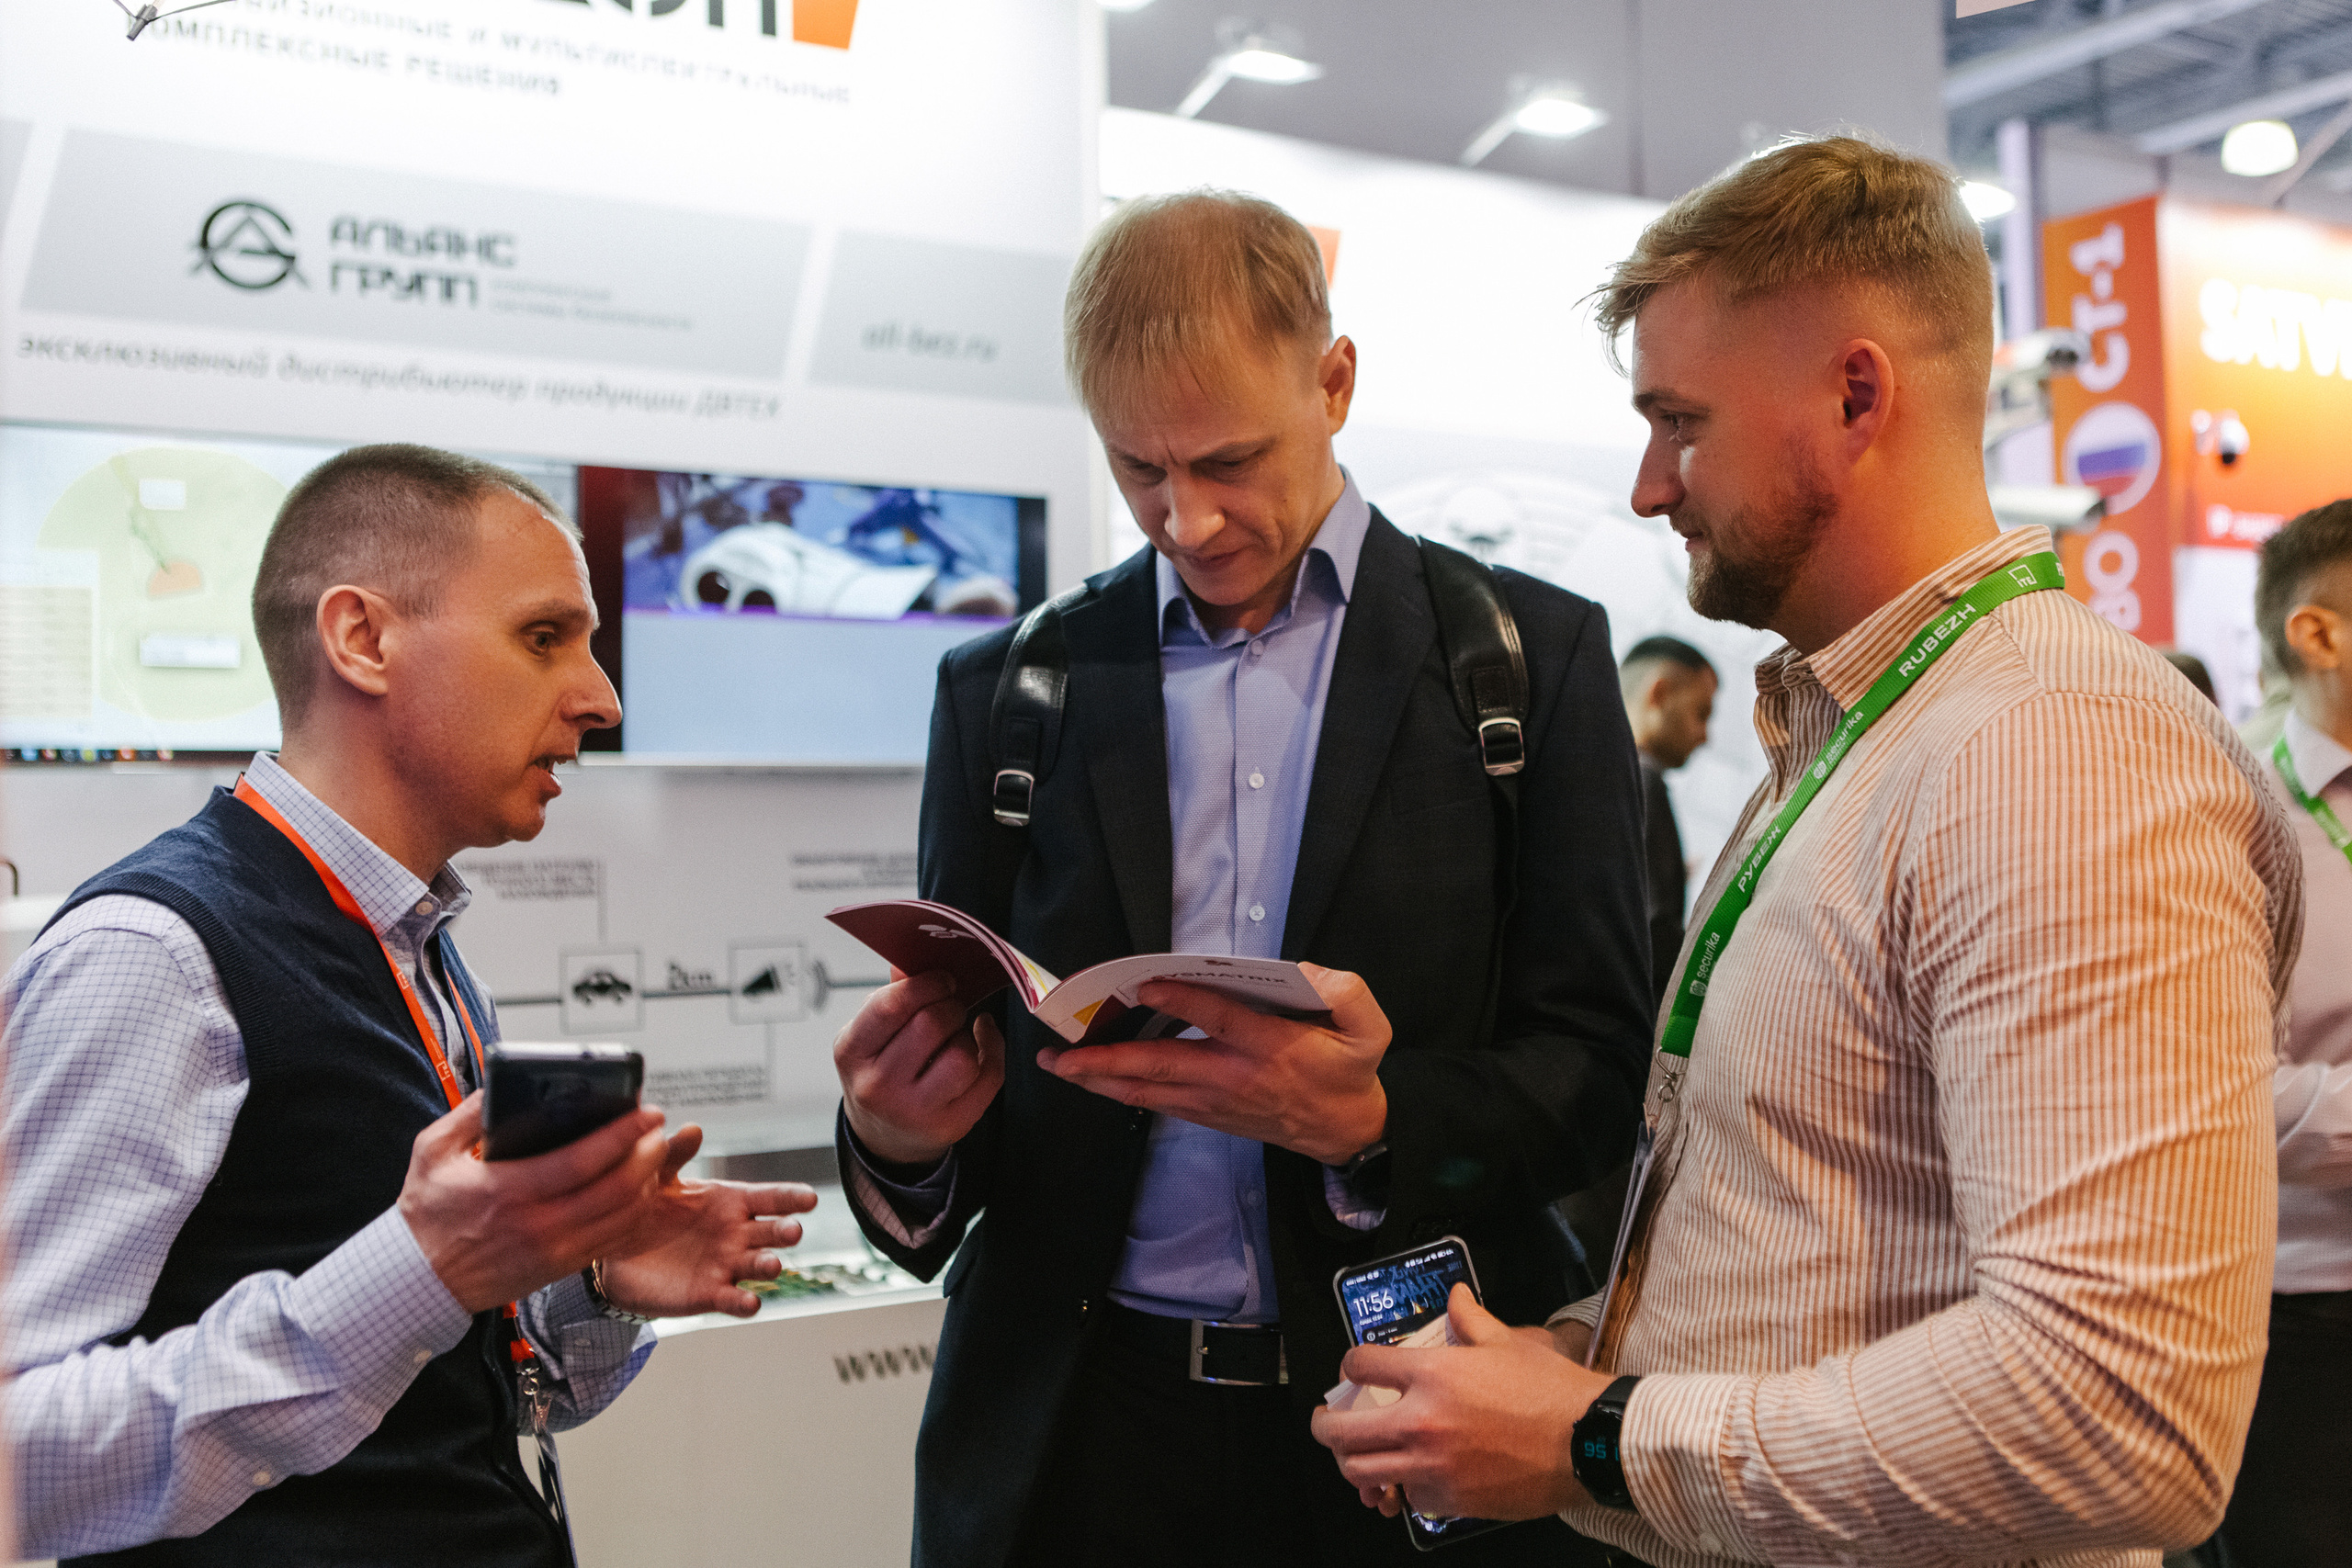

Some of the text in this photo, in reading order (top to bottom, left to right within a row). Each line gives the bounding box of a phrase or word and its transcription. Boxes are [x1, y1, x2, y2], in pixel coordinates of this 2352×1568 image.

[404, 49, 561, 97] РЕШЕНИЯ
[330, 263, 478, 308] ГРУПП
[1897, 603, 1976, 678] RUBEZH
[1737, 825, 1782, 894] РУБЕЖ
[1696, 931, 1721, 978] securika
[1353, 1289, 1395, 1317] 11:56
